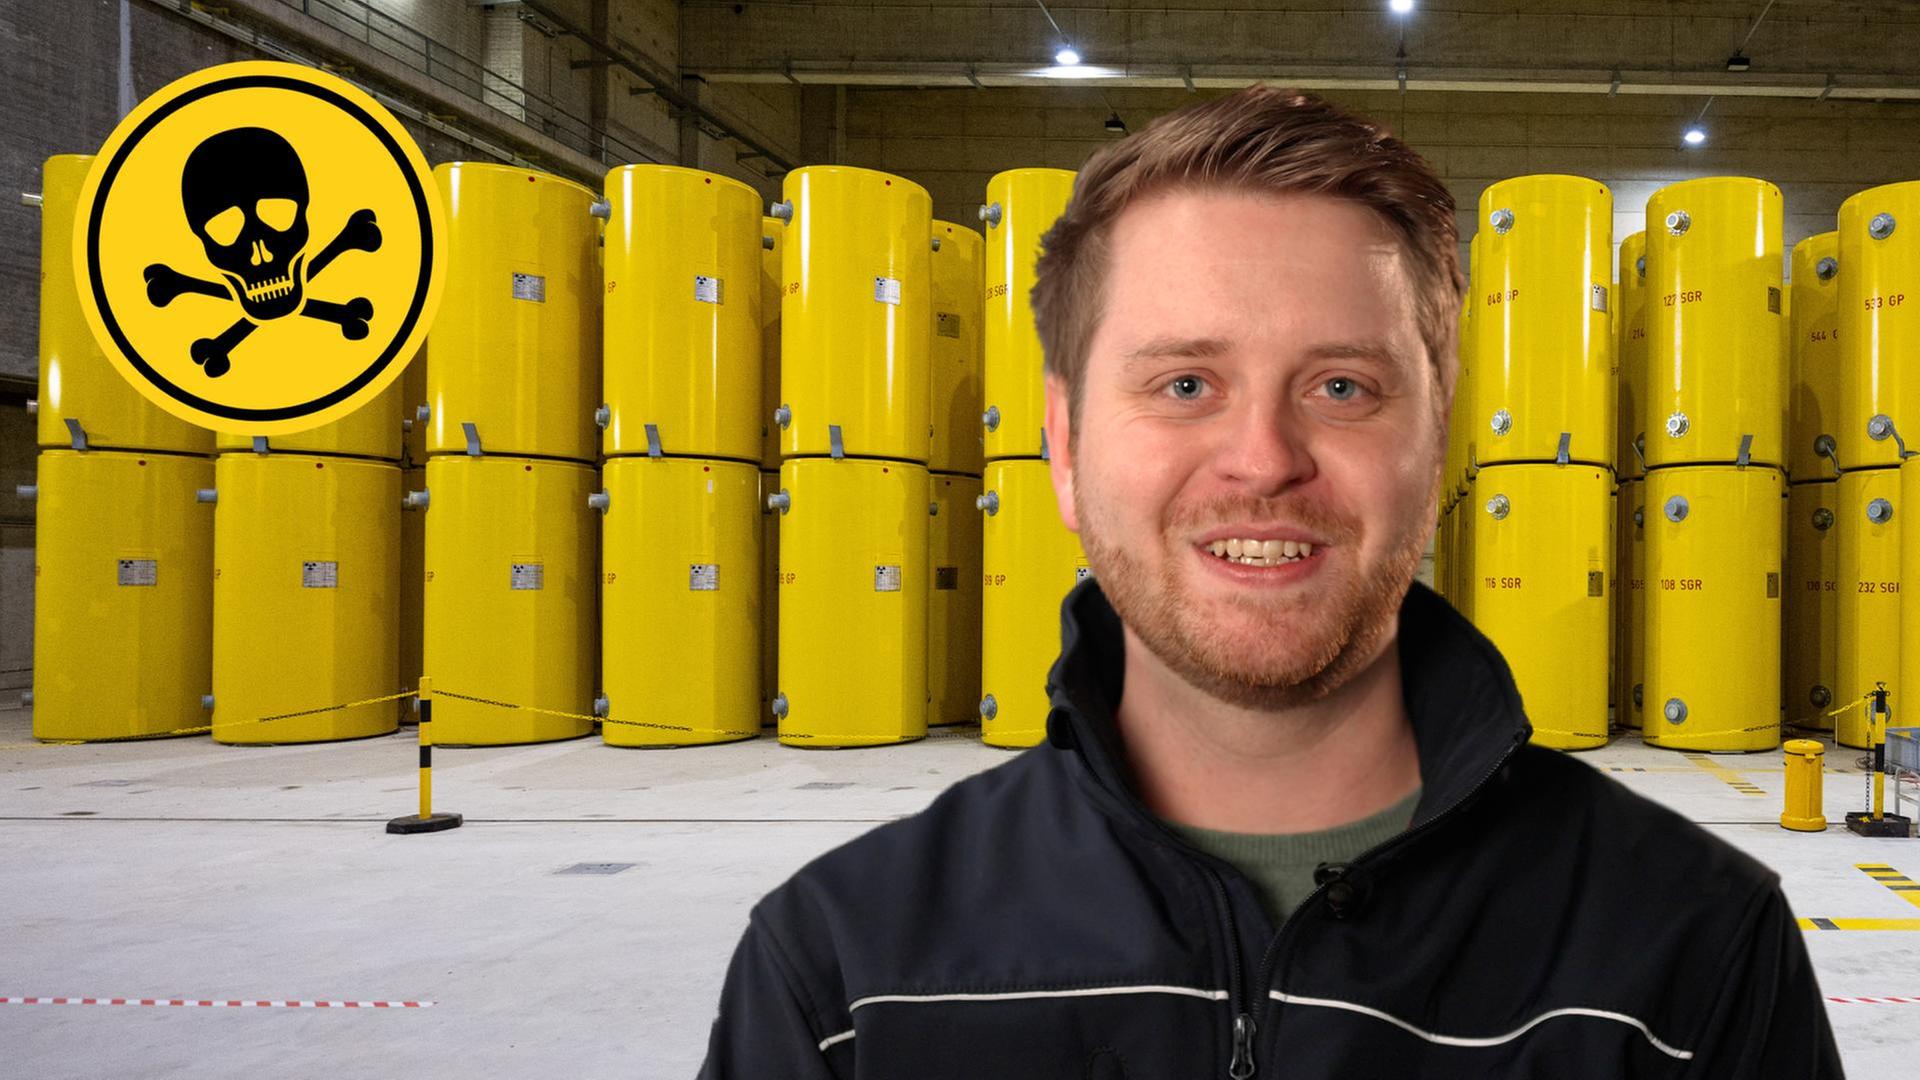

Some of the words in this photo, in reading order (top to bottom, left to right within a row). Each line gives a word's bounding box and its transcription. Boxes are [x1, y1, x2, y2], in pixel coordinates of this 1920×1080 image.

[1680, 290, 1702, 304] SGR
[1888, 294, 1905, 307] GP
[995, 574, 1006, 587] GP
[1501, 577, 1521, 590] SGR
[1660, 579, 1676, 591] 108
[1680, 579, 1703, 591] SGR
[1858, 582, 1876, 593] 232
